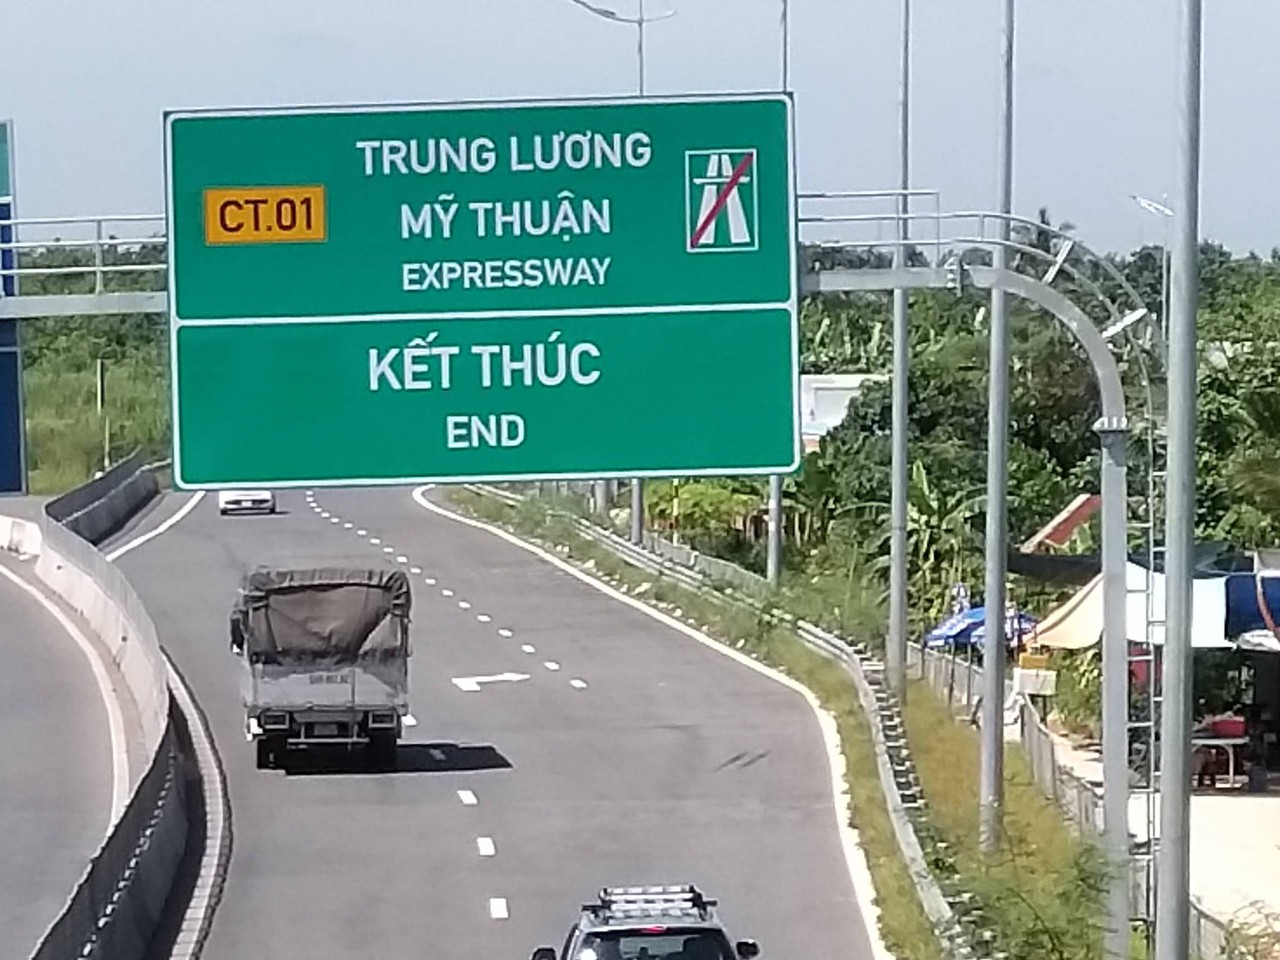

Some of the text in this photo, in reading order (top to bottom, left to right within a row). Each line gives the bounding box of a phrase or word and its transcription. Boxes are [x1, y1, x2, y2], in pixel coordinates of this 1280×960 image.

[356, 130, 652, 176] TRUNG LƯƠNG
[218, 196, 314, 233] CT.01
[401, 190, 611, 242] MỸ THUẬN
[402, 257, 612, 291] EXPRESSWAY
[368, 330, 601, 391] KẾT THÚC
[446, 414, 525, 449] END
